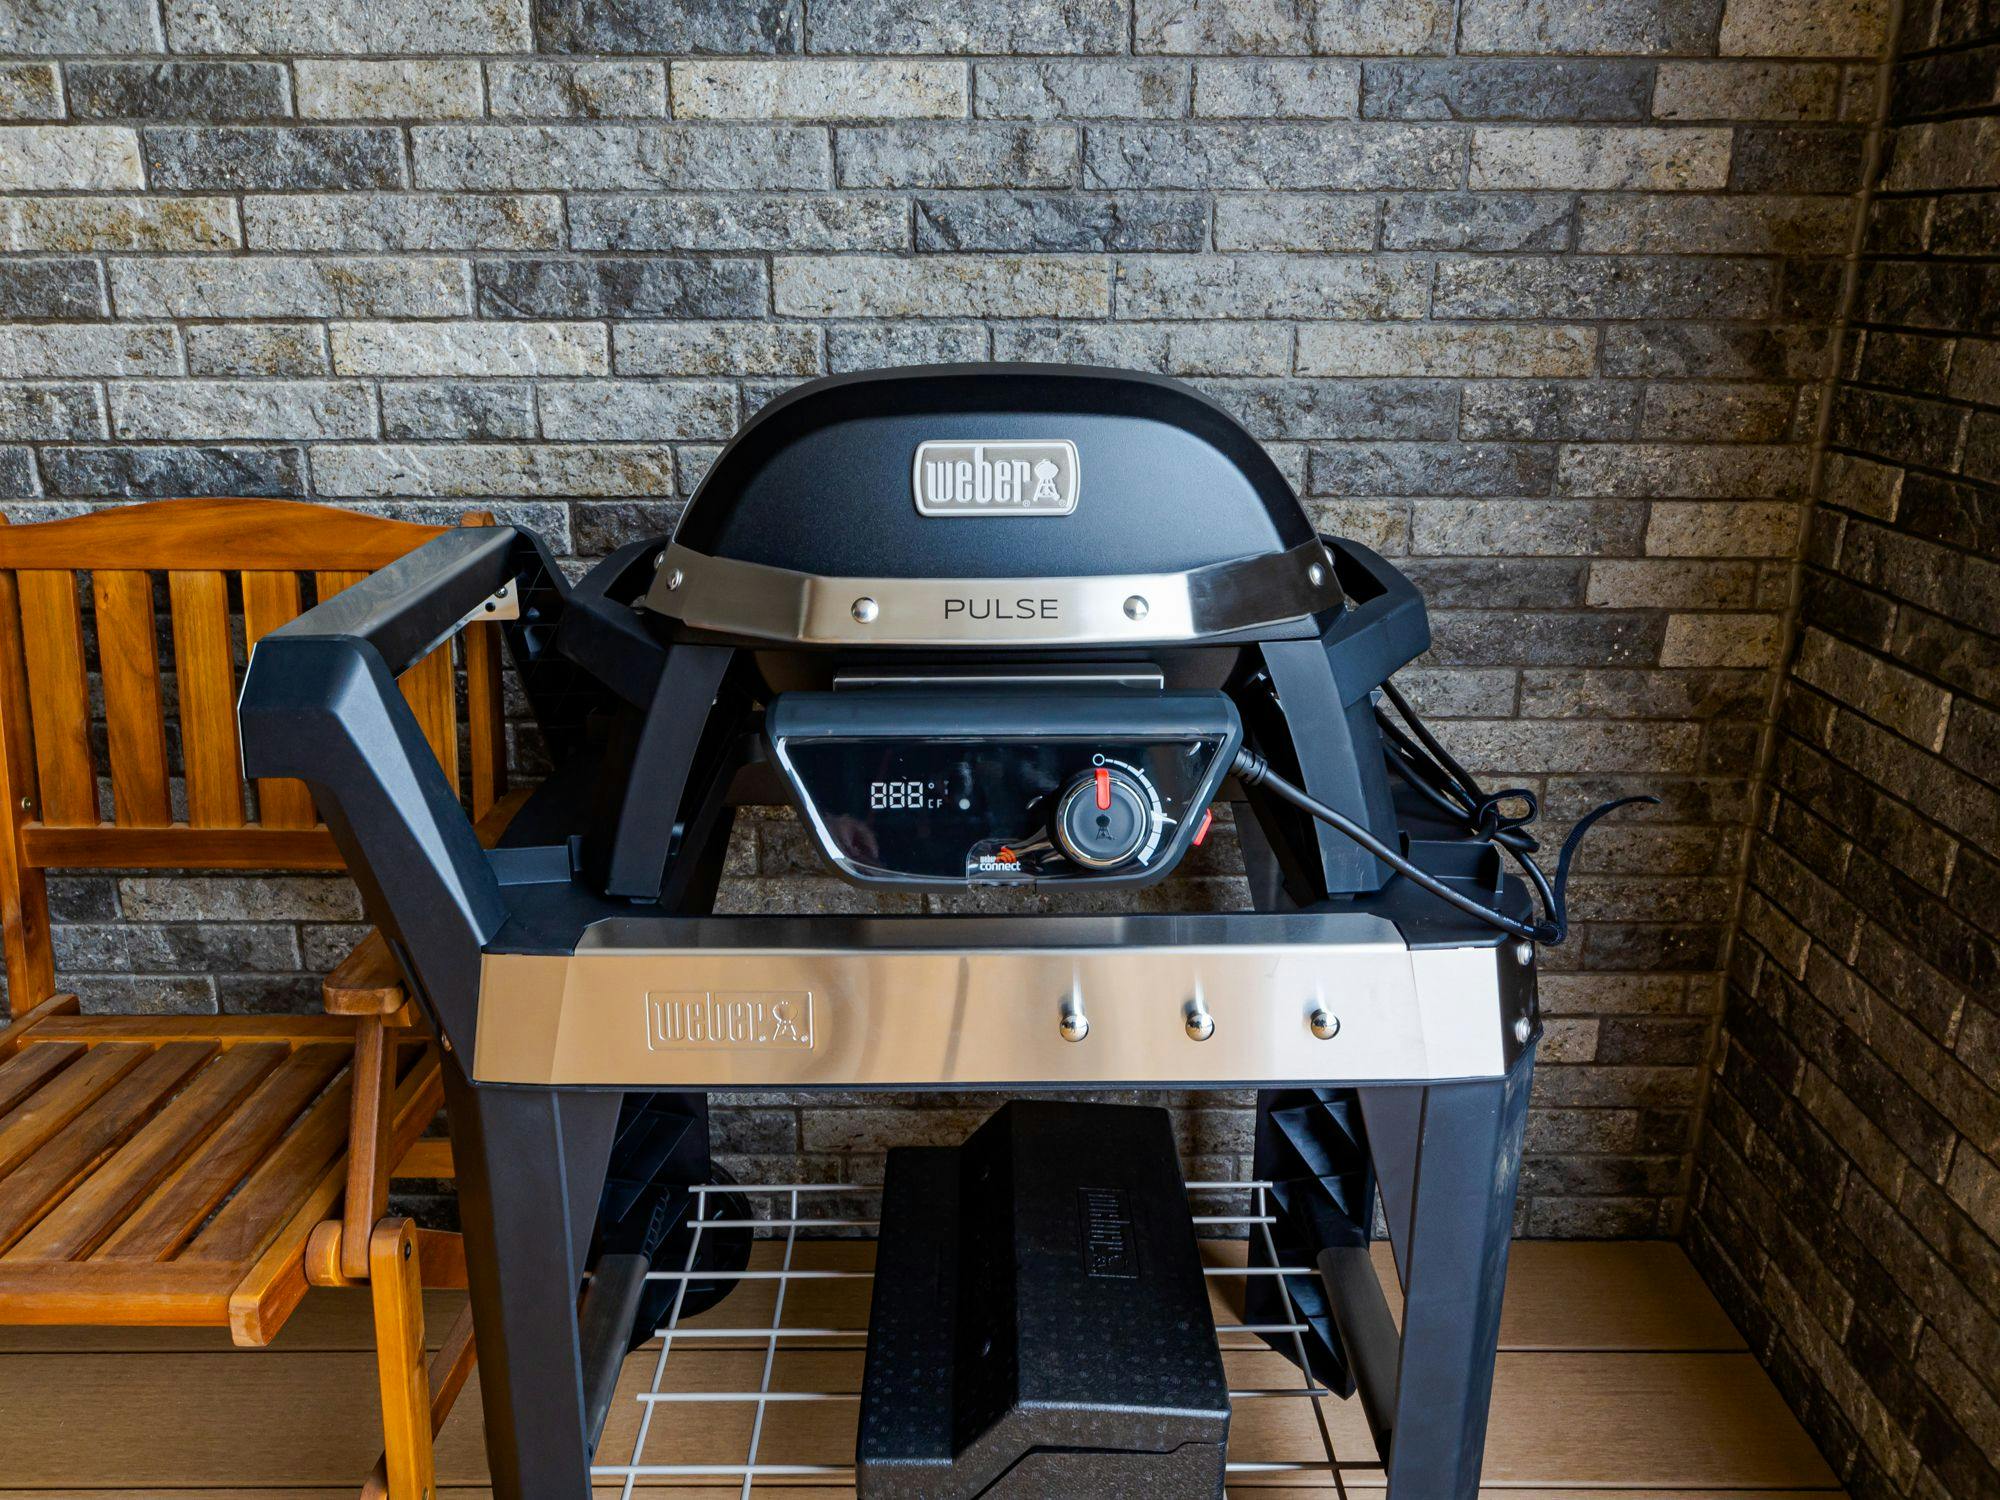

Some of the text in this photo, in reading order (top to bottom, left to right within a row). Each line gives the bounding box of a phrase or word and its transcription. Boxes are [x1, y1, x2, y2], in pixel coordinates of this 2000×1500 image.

[925, 446, 1031, 503] weber
[944, 598, 1059, 619] PULSE
[871, 781, 923, 809] 888
[980, 861, 1021, 871] connect
[654, 990, 768, 1042] weber
